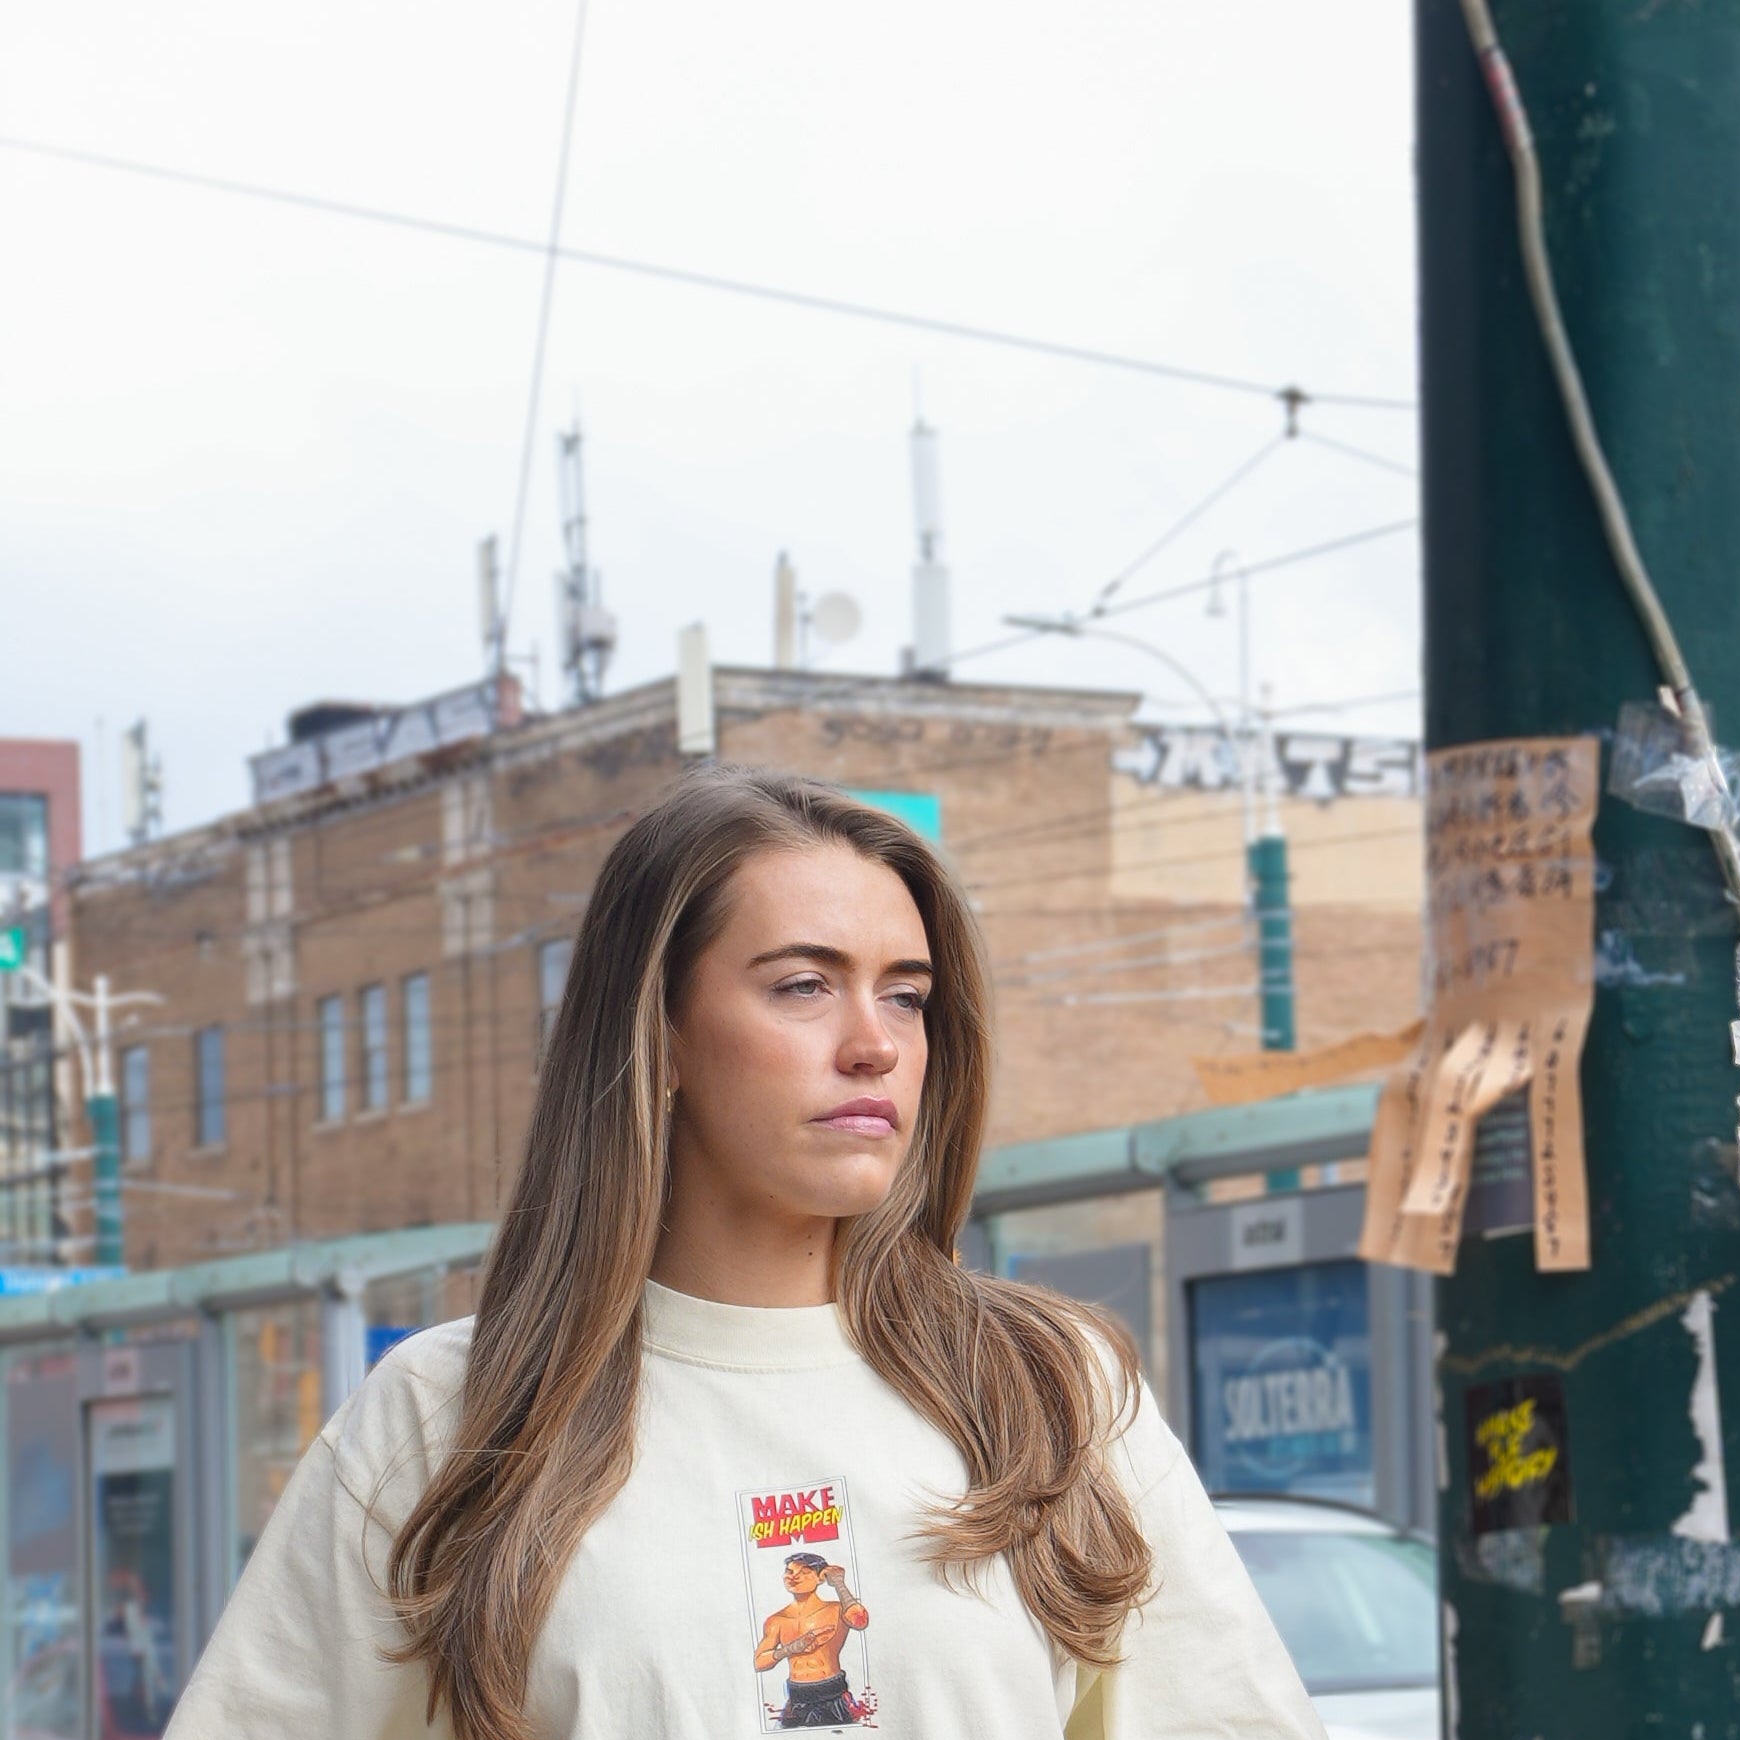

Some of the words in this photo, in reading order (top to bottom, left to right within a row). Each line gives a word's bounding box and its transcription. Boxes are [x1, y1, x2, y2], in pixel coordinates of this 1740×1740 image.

[752, 1487, 835, 1520] MAKE
[749, 1521, 774, 1541] ISH
[779, 1506, 842, 1536] HAPPEN
